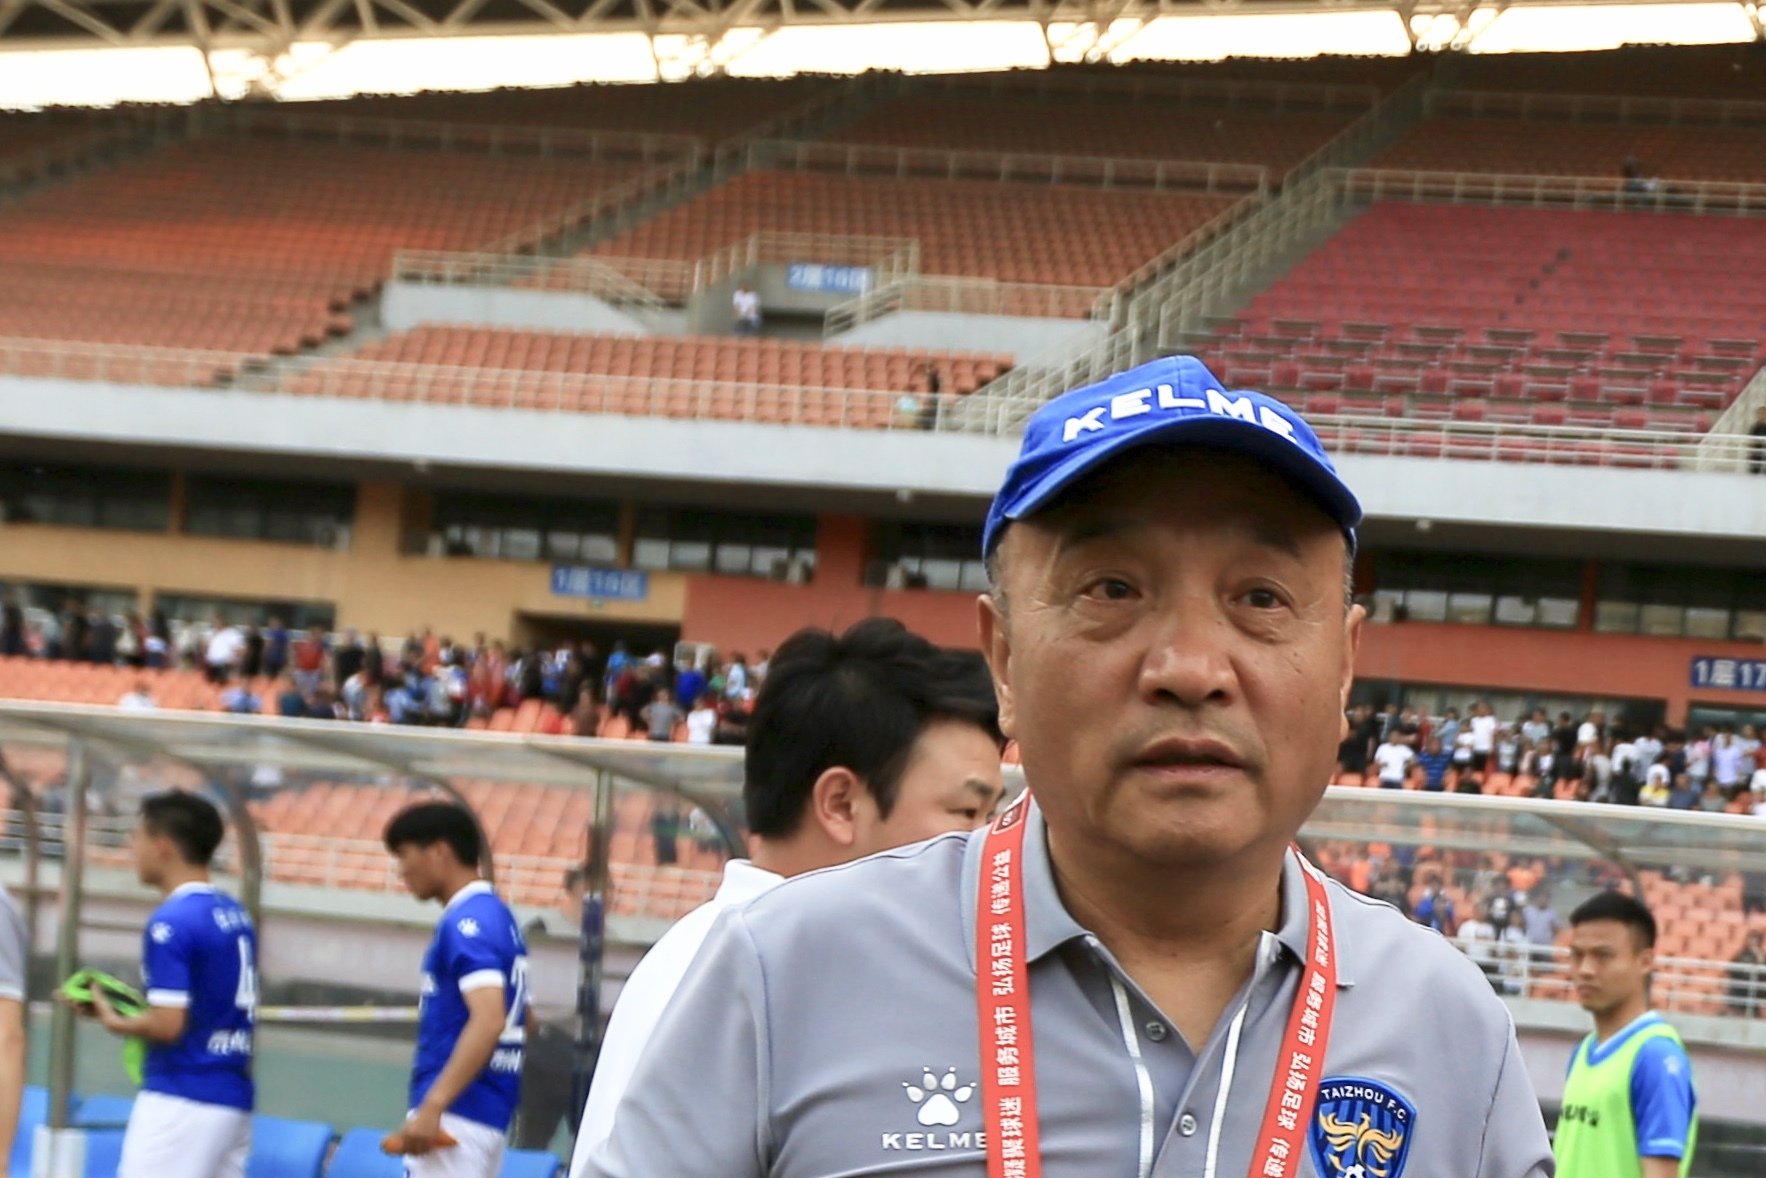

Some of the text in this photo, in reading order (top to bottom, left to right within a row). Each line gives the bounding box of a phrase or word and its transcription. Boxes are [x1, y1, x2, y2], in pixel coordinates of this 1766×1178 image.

[1063, 385, 1297, 443] KELME
[991, 848, 1012, 915] 传递公益
[991, 922, 1015, 997] 弘扬足球
[1297, 970, 1326, 1047] 服务城市
[993, 1005, 1021, 1087] 服务城市
[1277, 1051, 1311, 1131] 弘扬足球
[1321, 1086, 1407, 1123] TAIZHOU F.C.
[882, 1132, 987, 1150] KELME
